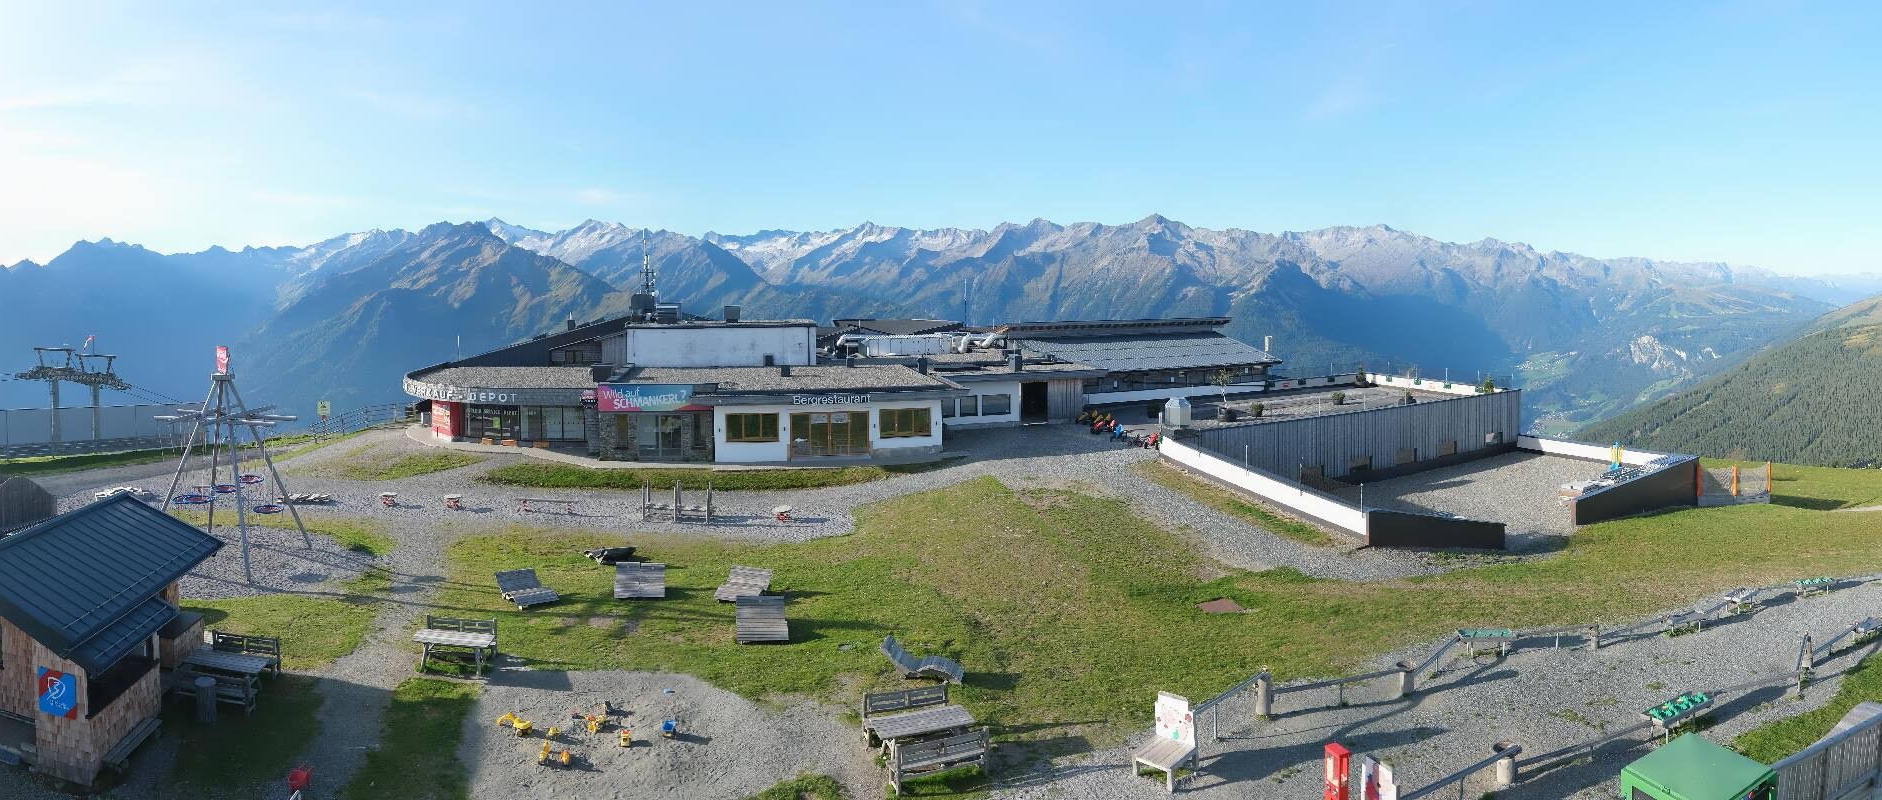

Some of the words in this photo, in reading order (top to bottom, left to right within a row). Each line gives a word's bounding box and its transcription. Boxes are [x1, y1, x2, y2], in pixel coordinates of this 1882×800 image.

[468, 393, 519, 403] DEPOT
[602, 389, 623, 400] Wild
[625, 387, 640, 398] auf
[613, 390, 687, 410] SCHMANKERL?
[793, 394, 871, 406] Bergrestaurant
